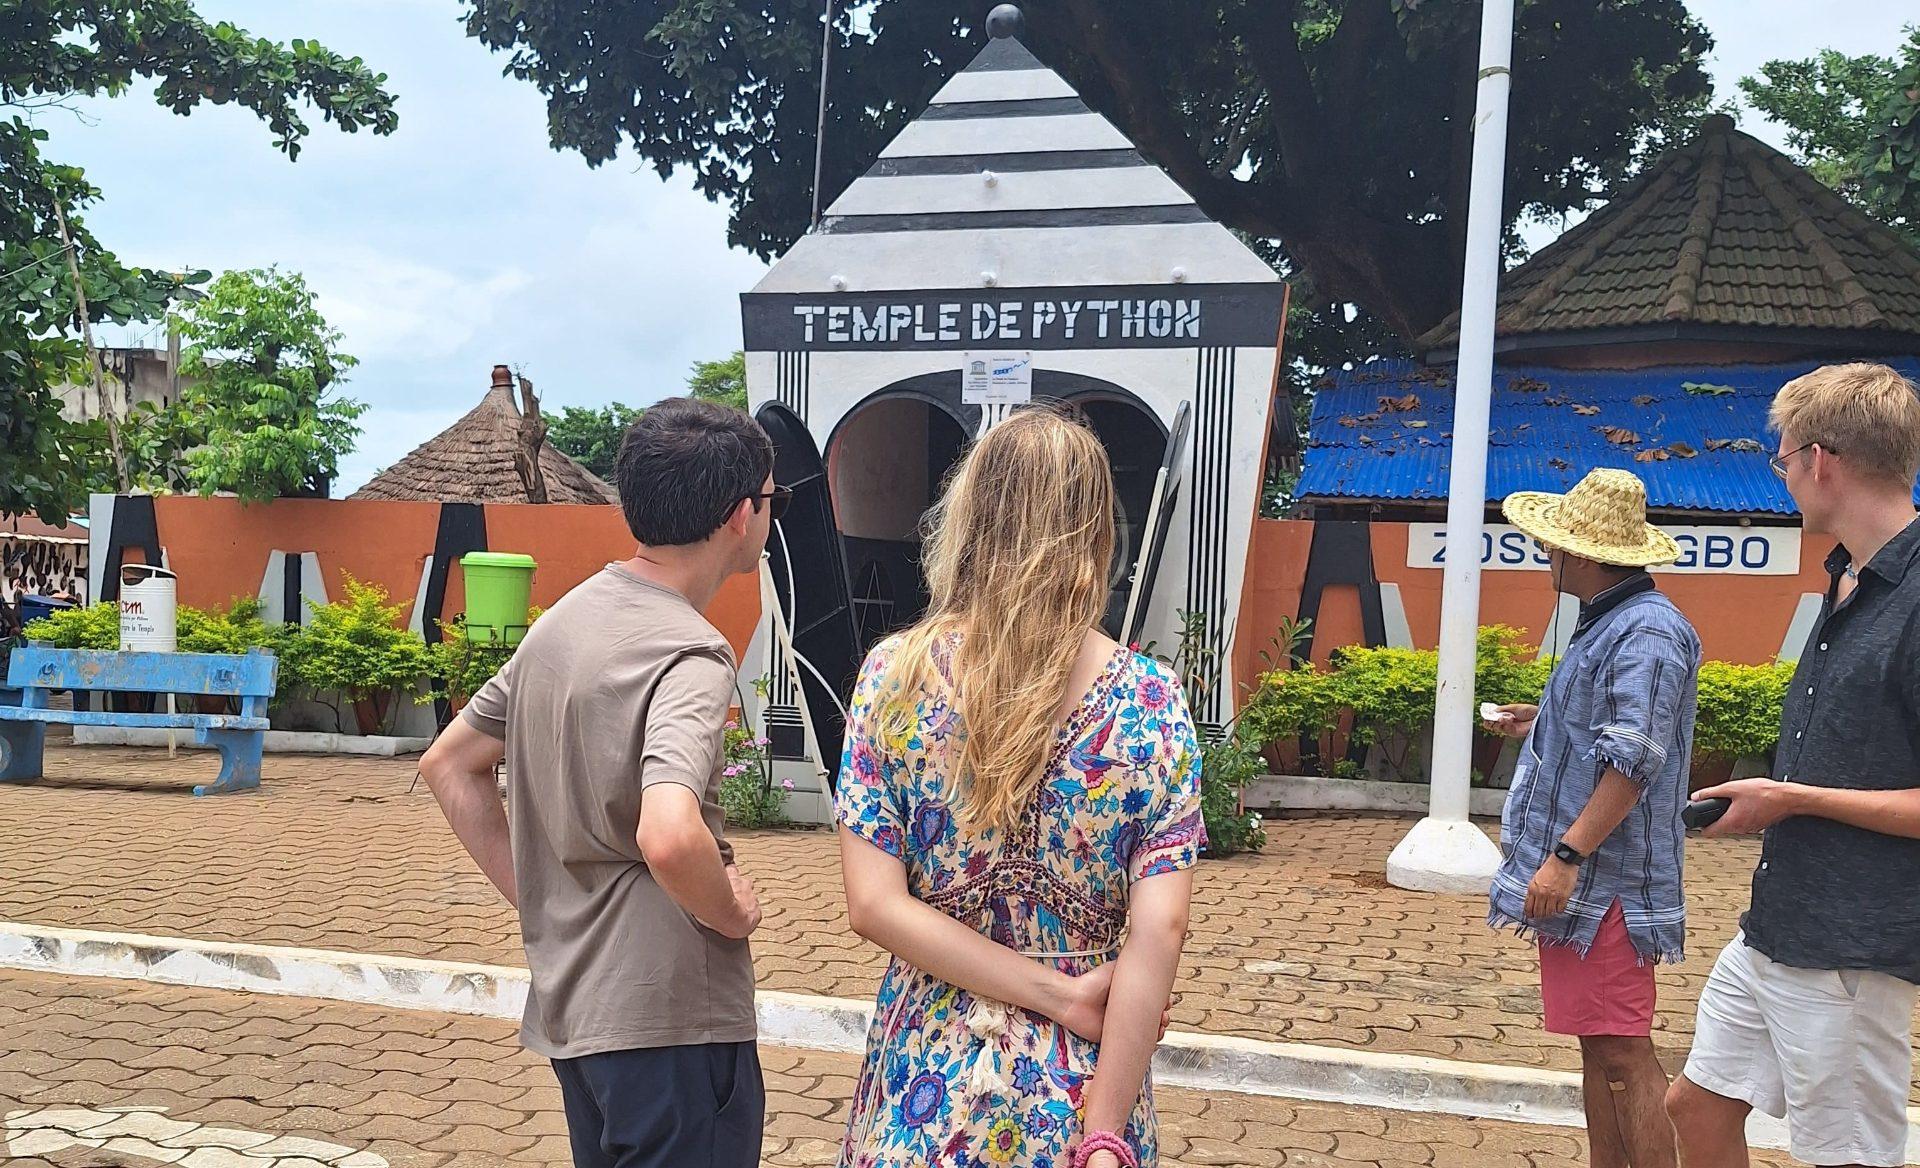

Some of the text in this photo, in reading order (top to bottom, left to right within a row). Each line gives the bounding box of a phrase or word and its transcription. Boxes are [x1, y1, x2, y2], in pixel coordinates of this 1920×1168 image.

[794, 299, 1200, 342] TEMPLE DE PYTHON
